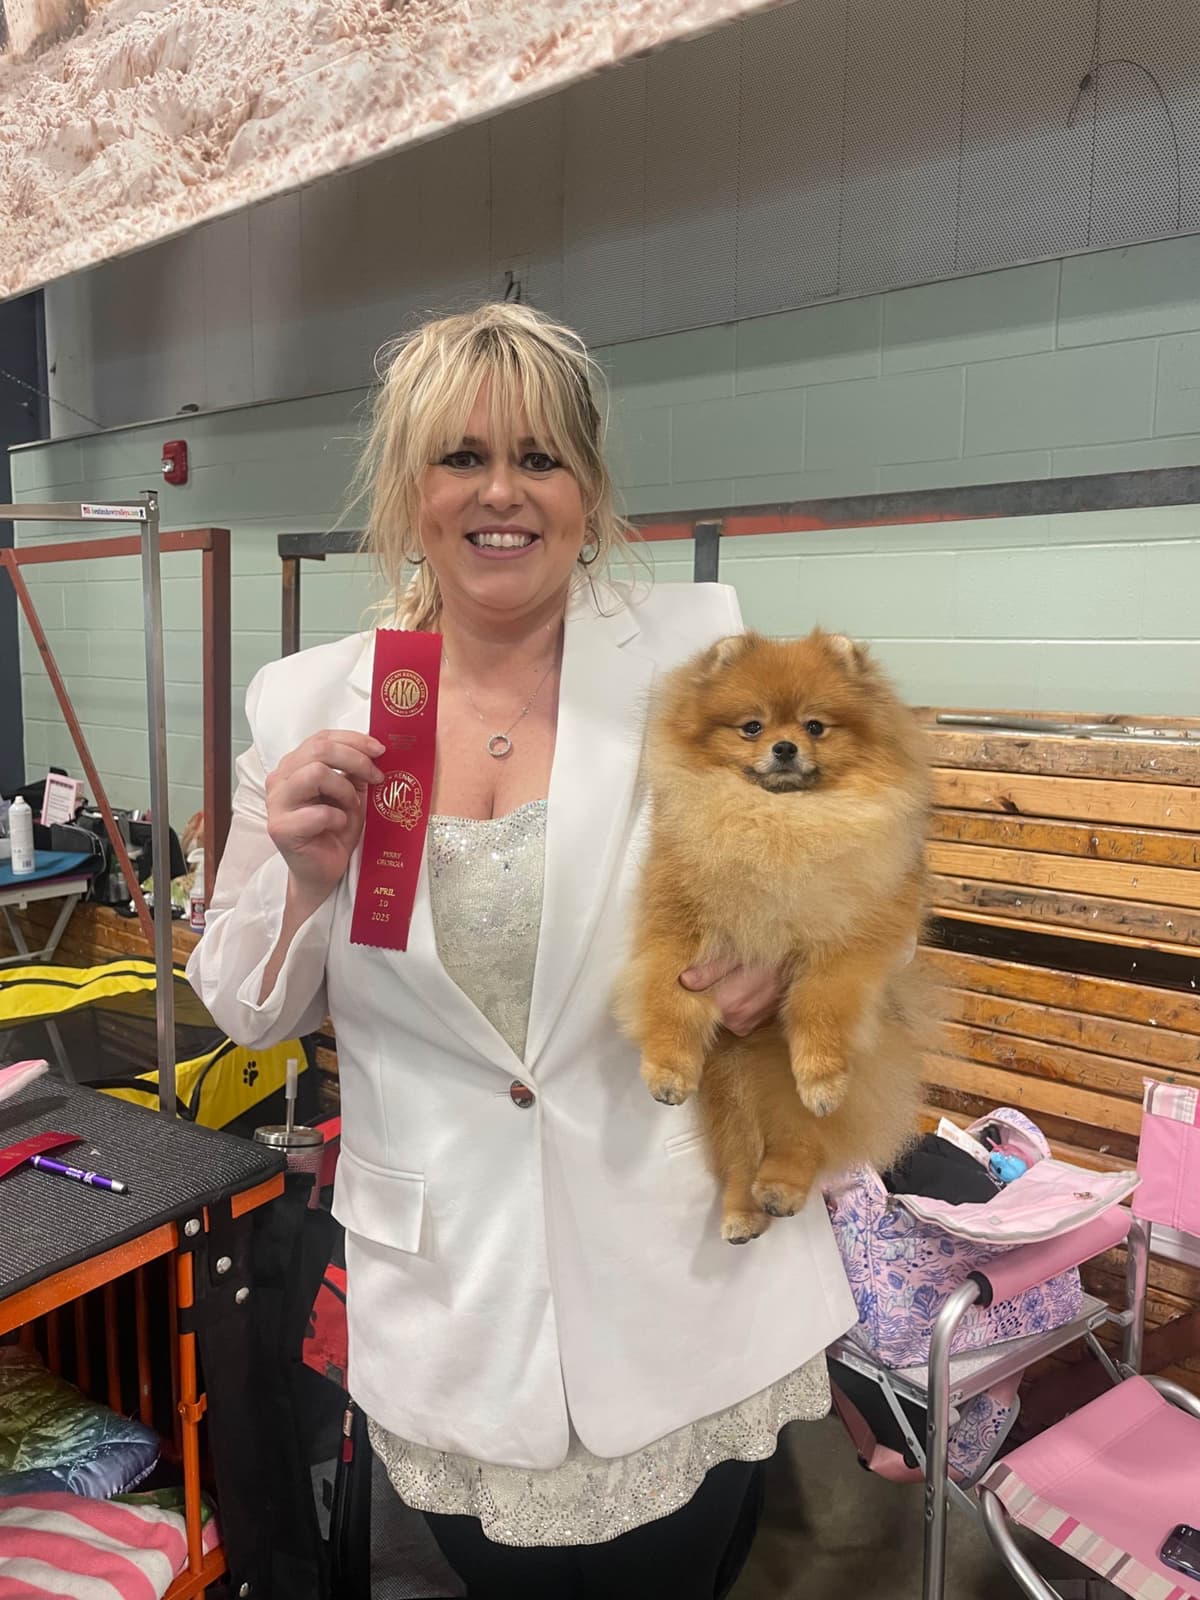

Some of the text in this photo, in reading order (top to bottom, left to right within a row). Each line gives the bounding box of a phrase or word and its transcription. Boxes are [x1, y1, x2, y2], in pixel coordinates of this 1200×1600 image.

[403, 672, 421, 686] KENNEL
[391, 680, 419, 707] AKC
[383, 851, 402, 859] PERRY
[376, 859, 404, 867] GEORGIA
[373, 887, 395, 897] APRIL
[371, 912, 391, 922] 2025
